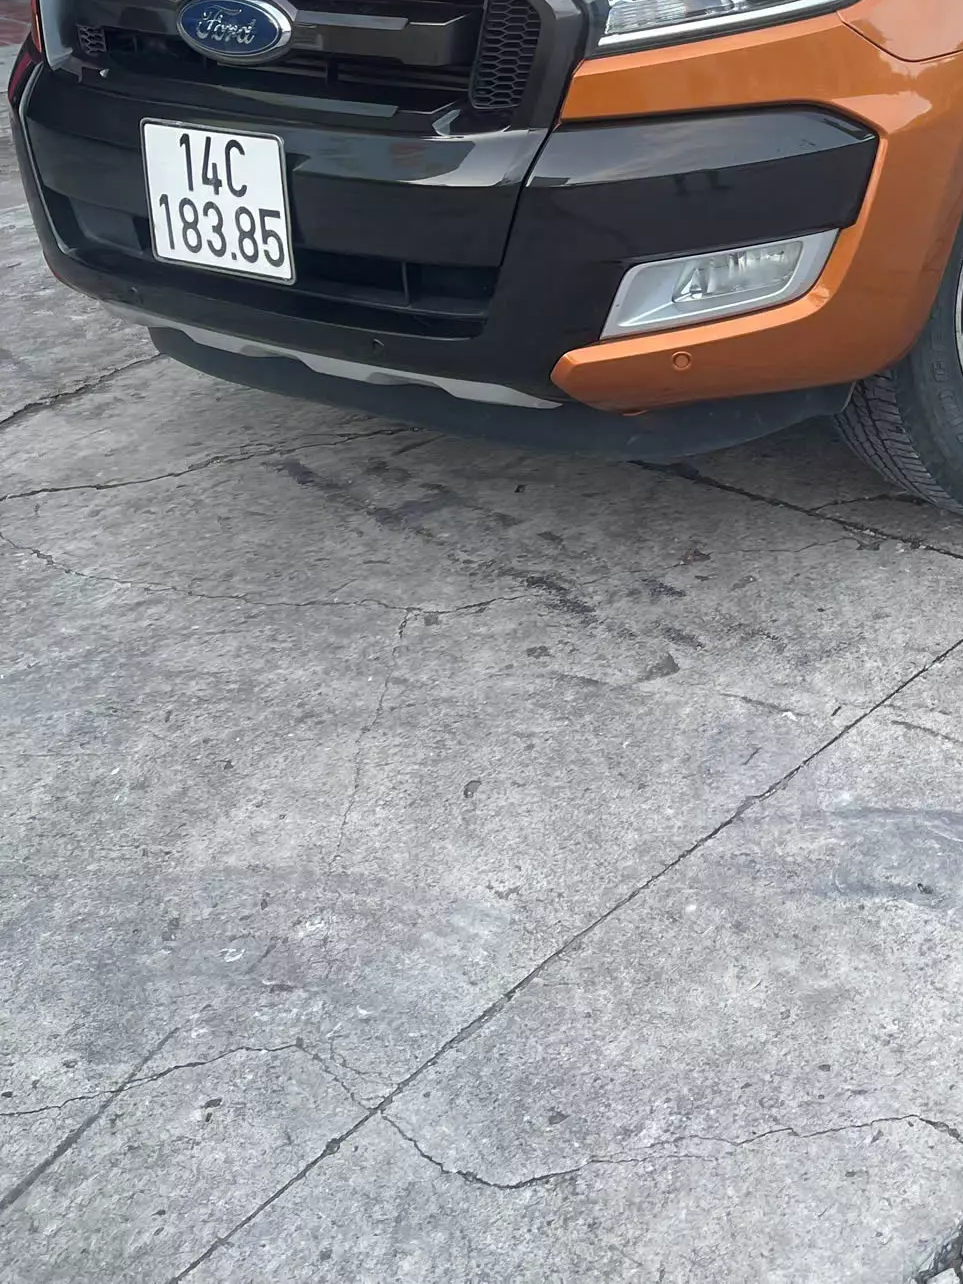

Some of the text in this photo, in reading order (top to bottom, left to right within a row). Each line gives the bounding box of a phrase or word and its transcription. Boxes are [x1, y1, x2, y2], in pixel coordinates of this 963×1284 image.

[197, 5, 259, 46] Ford
[178, 133, 248, 198] 14C
[158, 194, 285, 268] 183.85
